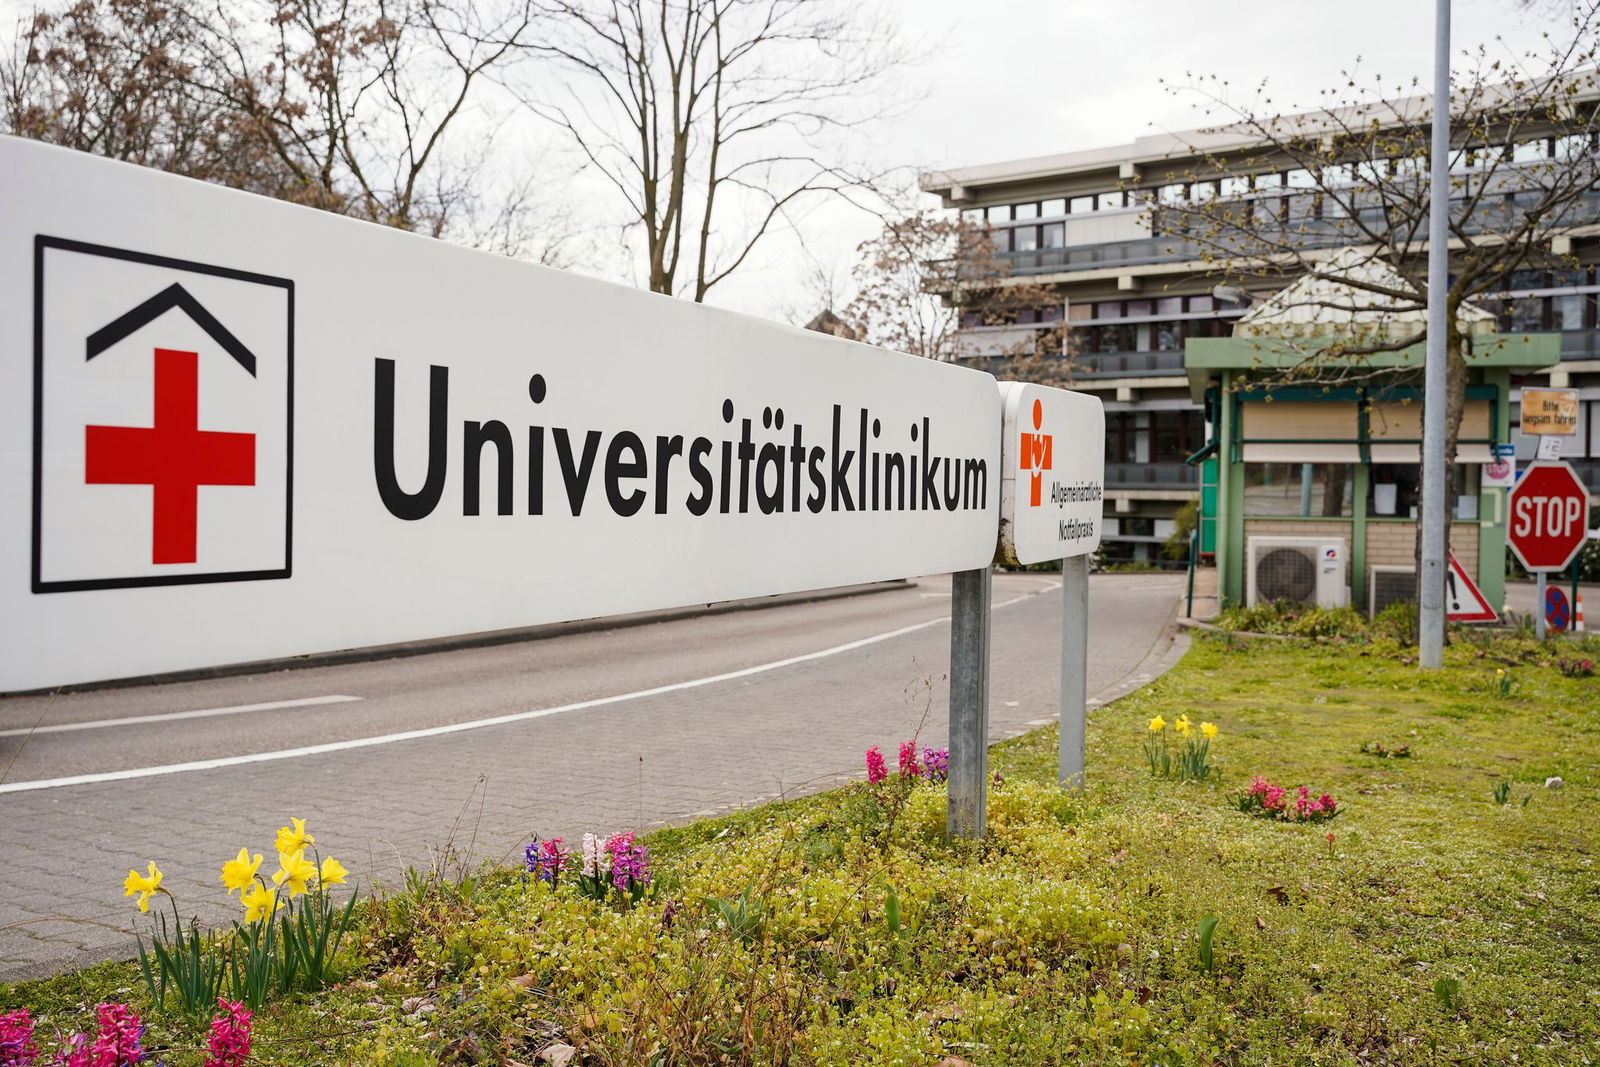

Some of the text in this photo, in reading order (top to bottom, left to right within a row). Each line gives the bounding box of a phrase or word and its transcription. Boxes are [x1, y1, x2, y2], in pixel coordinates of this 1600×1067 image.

[374, 357, 988, 521] Universitätsklinikum
[1051, 481, 1101, 509] Allgemeinärztliche
[1059, 517, 1094, 544] Notfallpraxis
[1514, 495, 1581, 538] STOP
